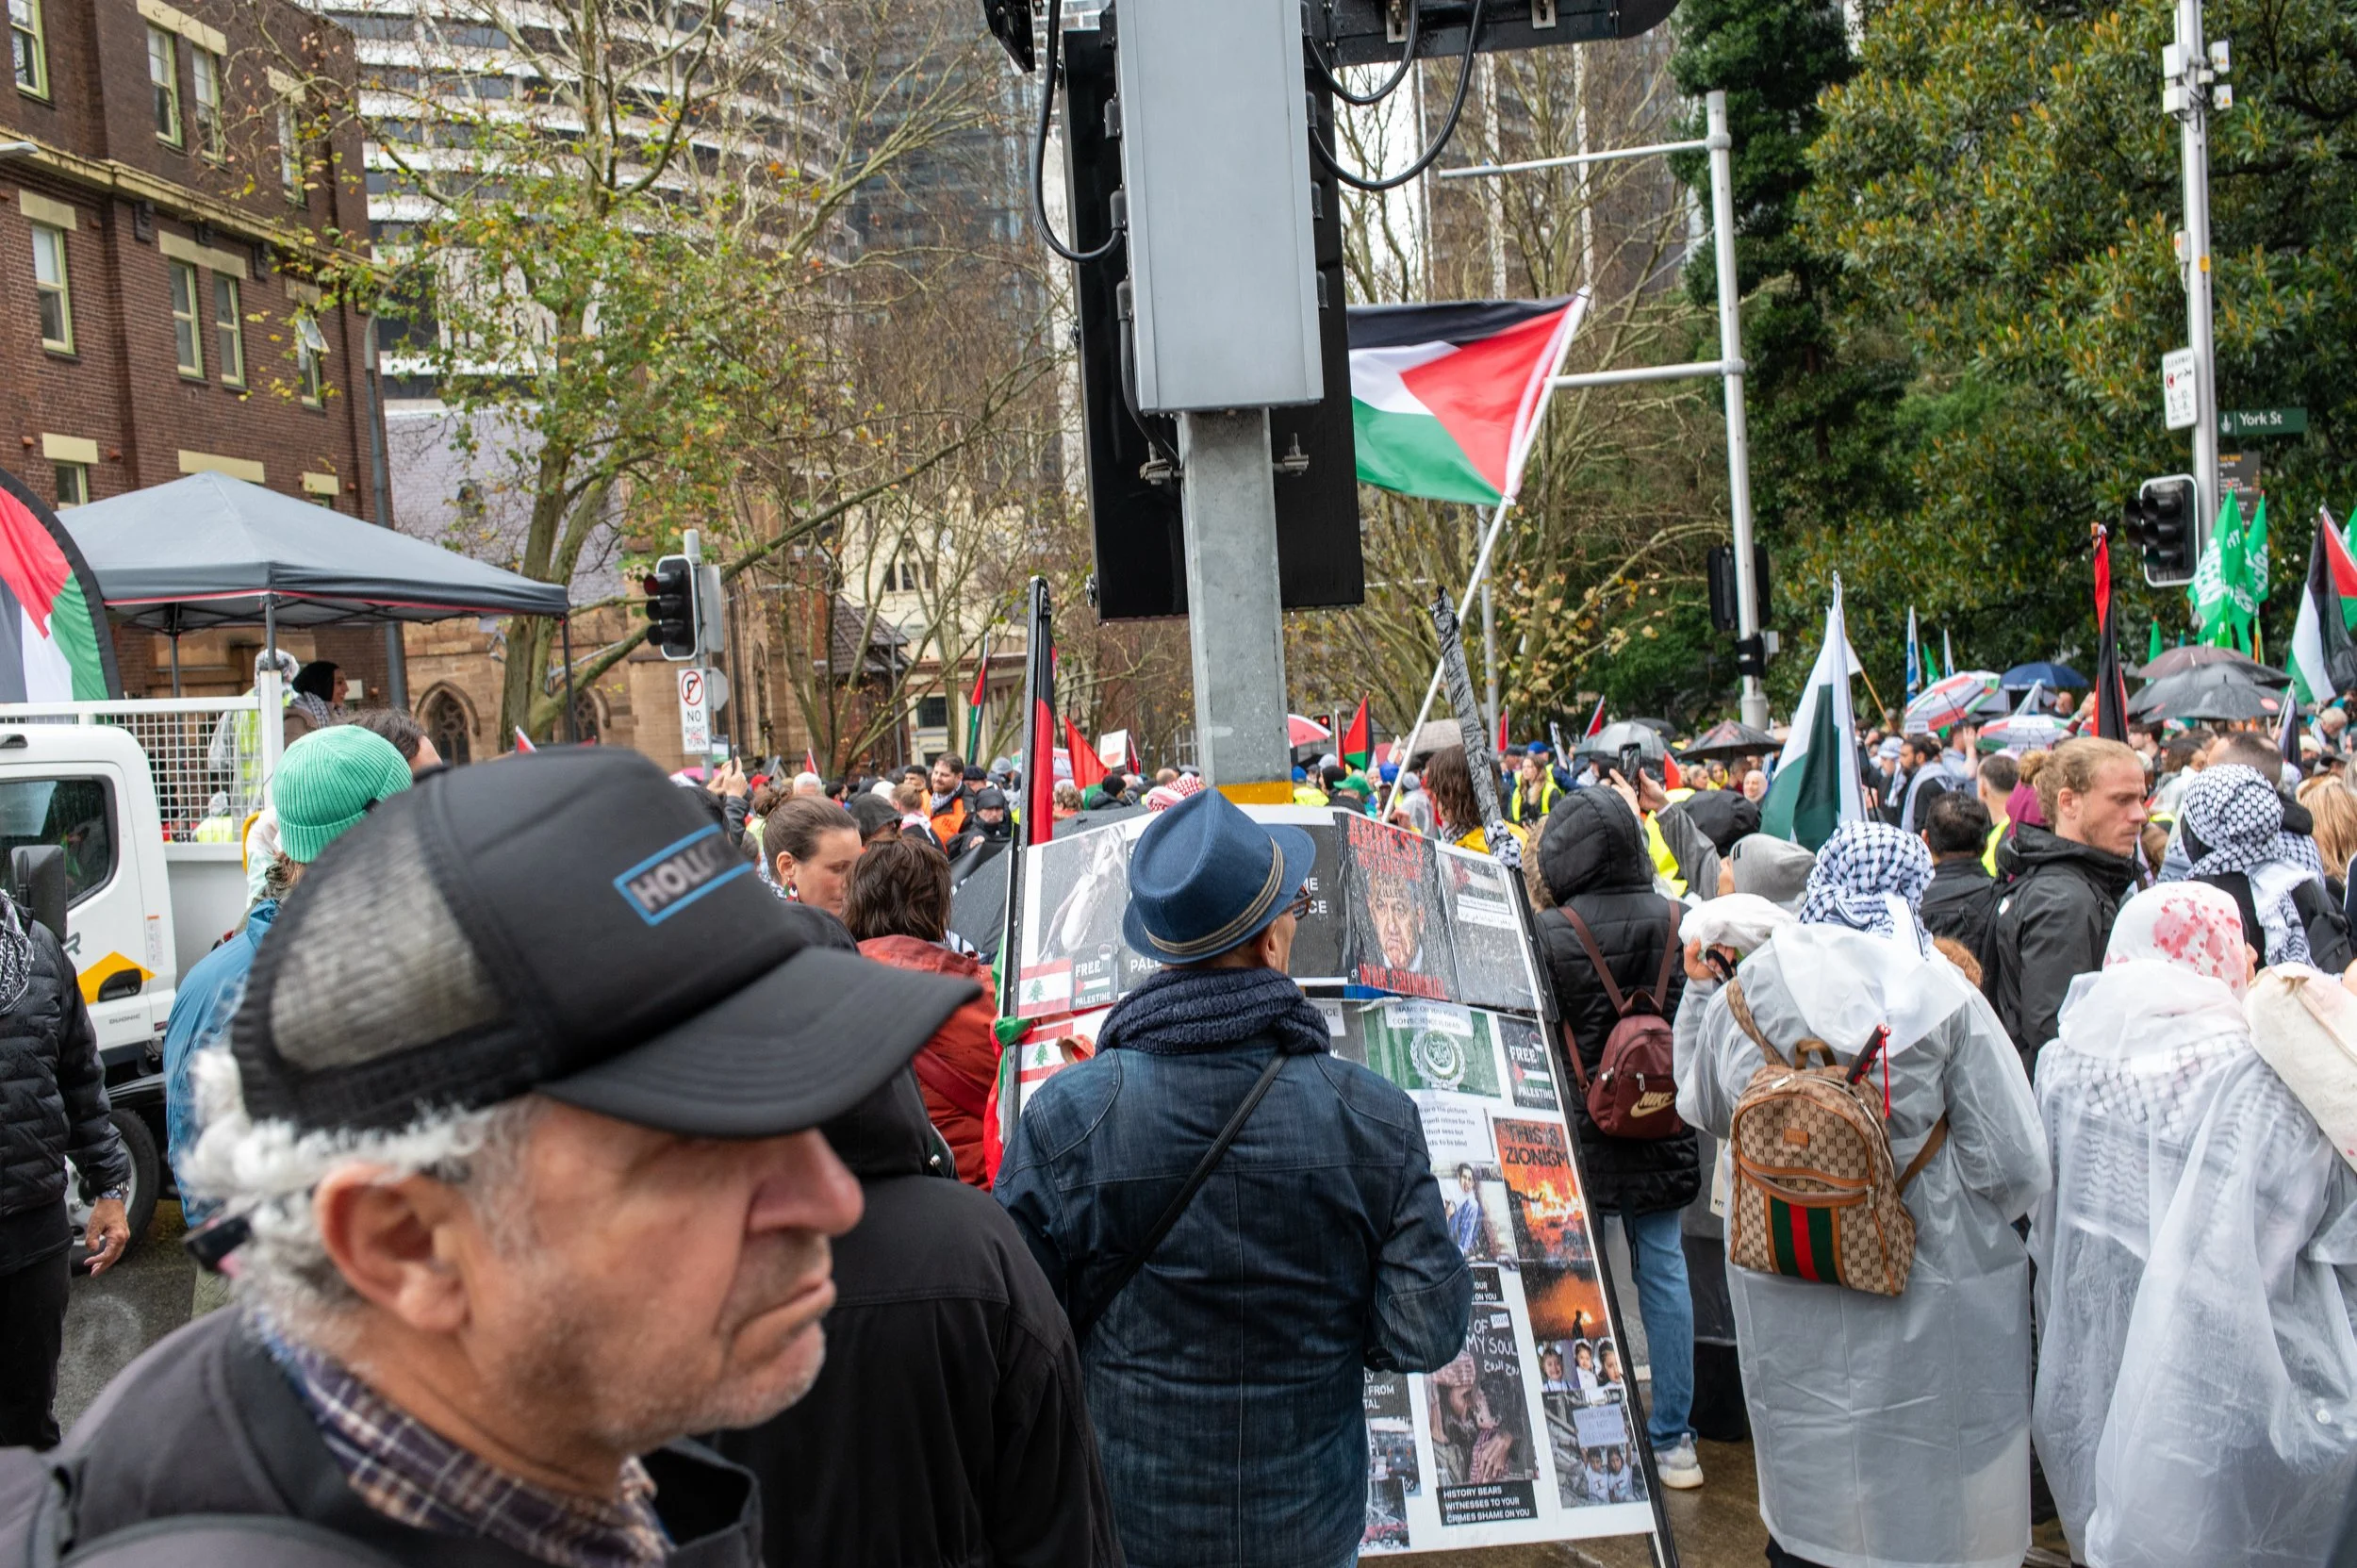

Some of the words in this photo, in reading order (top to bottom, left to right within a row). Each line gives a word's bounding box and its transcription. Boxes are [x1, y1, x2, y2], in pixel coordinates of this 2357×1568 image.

[2240, 411, 2267, 426] York
[2270, 410, 2283, 425] St
[687, 710, 701, 722] NO
[687, 738, 706, 747] TURN
[1349, 814, 1424, 866] ARREST
[1075, 960, 1101, 977] FREE
[1359, 962, 1389, 990] WAR
[1391, 968, 1449, 1000] CRIMINAL
[1075, 991, 1112, 1007] PALESTINE
[1508, 1044, 1538, 1064] FREE
[1518, 1085, 1556, 1100] PALESTINE
[1639, 1091, 1673, 1108] NIKE
[1508, 1125, 1542, 1144] THIS
[1506, 1147, 1571, 1168] ZIONISM
[1474, 1318, 1489, 1336] OF
[1465, 1332, 1485, 1355] MY
[1489, 1337, 1518, 1357] SOUL
[1368, 1384, 1394, 1395] FROM
[1443, 1488, 1476, 1498] HISTORY
[1477, 1486, 1502, 1495] BEARS
[1444, 1499, 1490, 1510] WITNESSES
[1491, 1497, 1501, 1507] TO
[1501, 1496, 1520, 1507] YOUR
[1446, 1512, 1476, 1524] CRIMES
[1477, 1510, 1504, 1521] SHAME
[1505, 1510, 1515, 1518] ON
[1515, 1509, 1530, 1518] YOU
